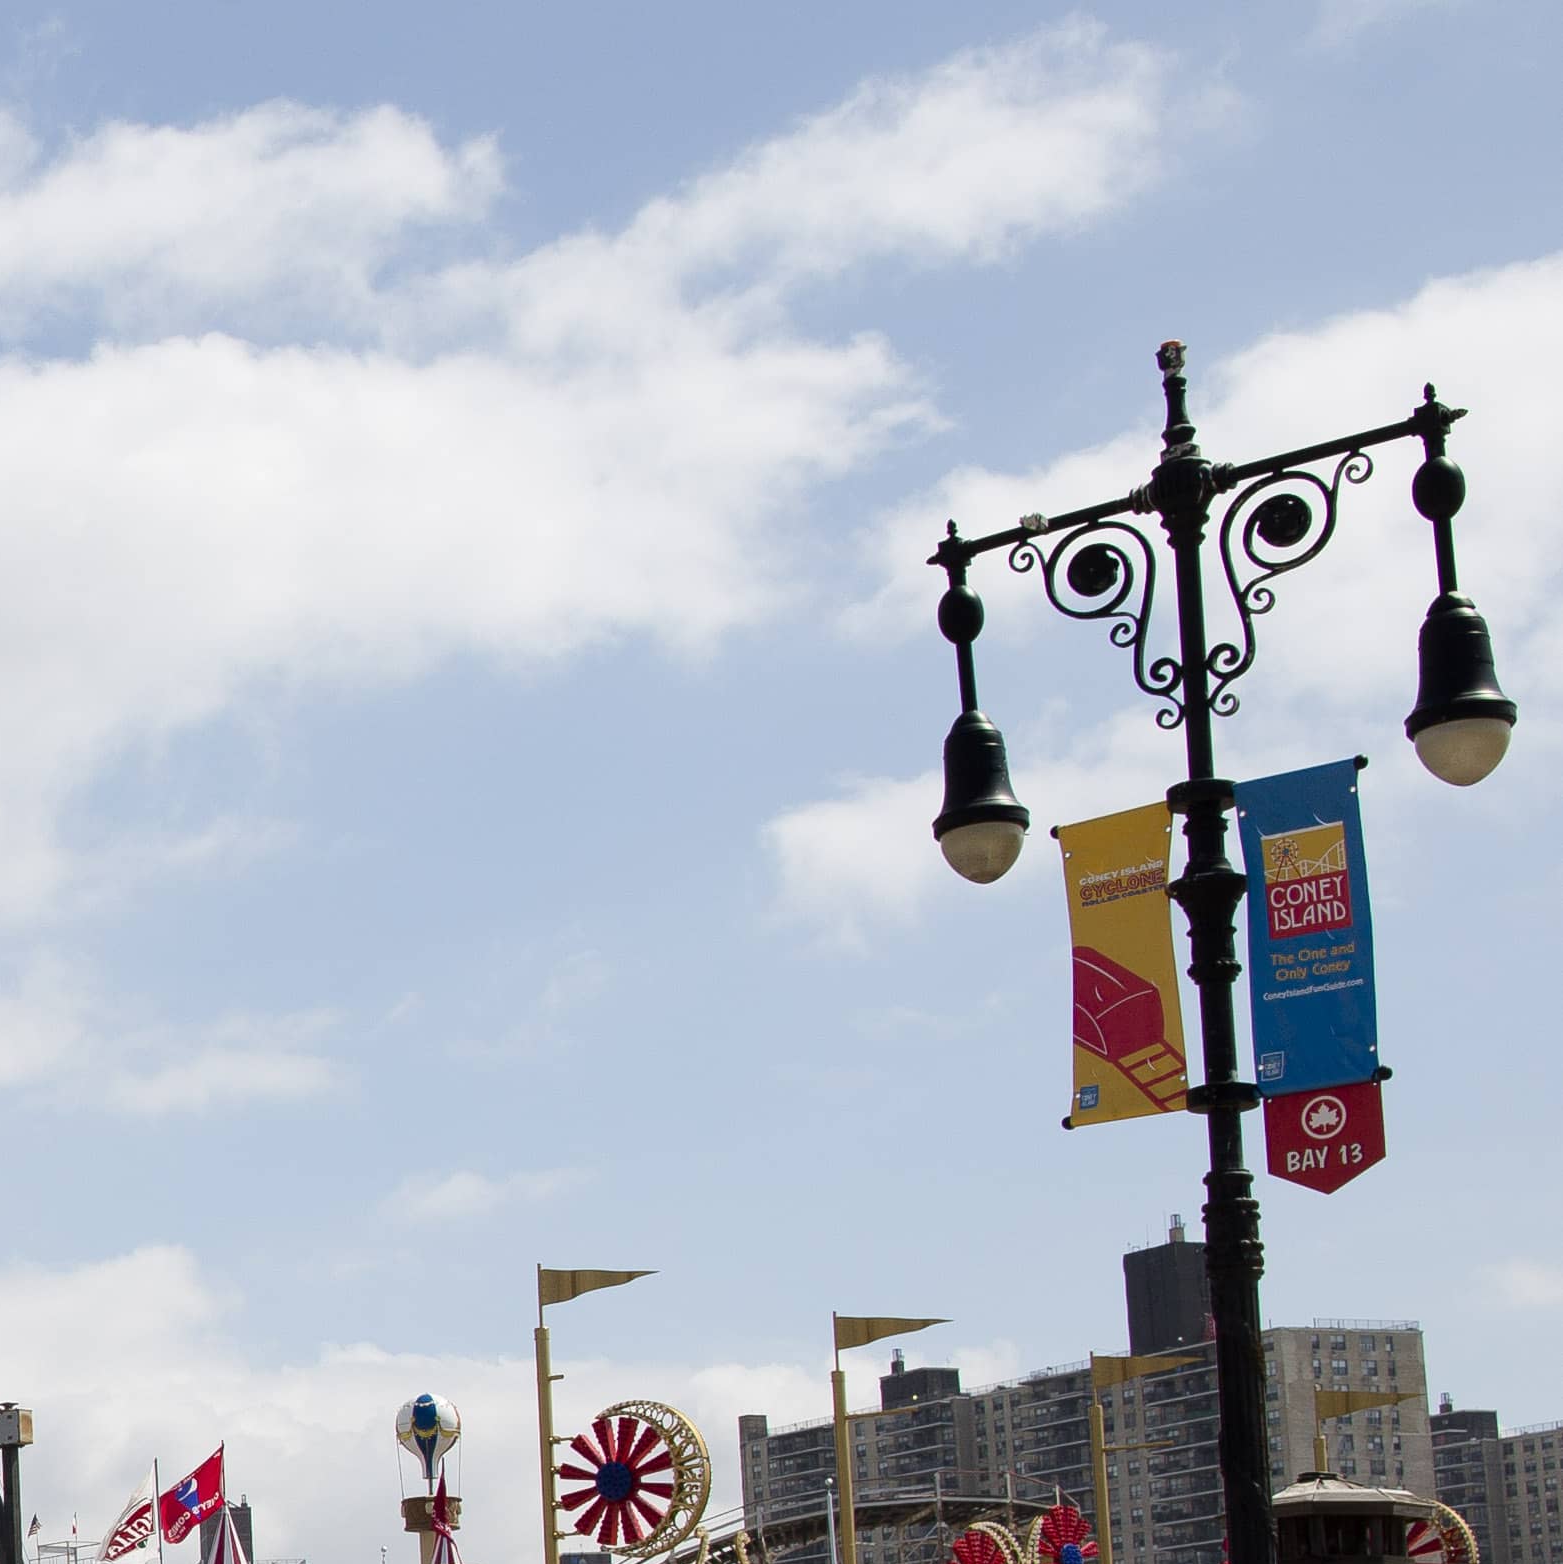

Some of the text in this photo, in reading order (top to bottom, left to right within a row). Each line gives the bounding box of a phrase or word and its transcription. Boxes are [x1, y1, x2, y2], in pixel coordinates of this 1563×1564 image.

[1079, 859, 1163, 886] CONEY ISLAND
[1080, 868, 1165, 901] CYCLONE
[1270, 875, 1344, 908] CONEY
[1274, 901, 1346, 931] ISLAND
[1270, 941, 1355, 966] The One and
[1275, 960, 1351, 981] Only Coney
[1286, 1143, 1363, 1173] BAY 13
